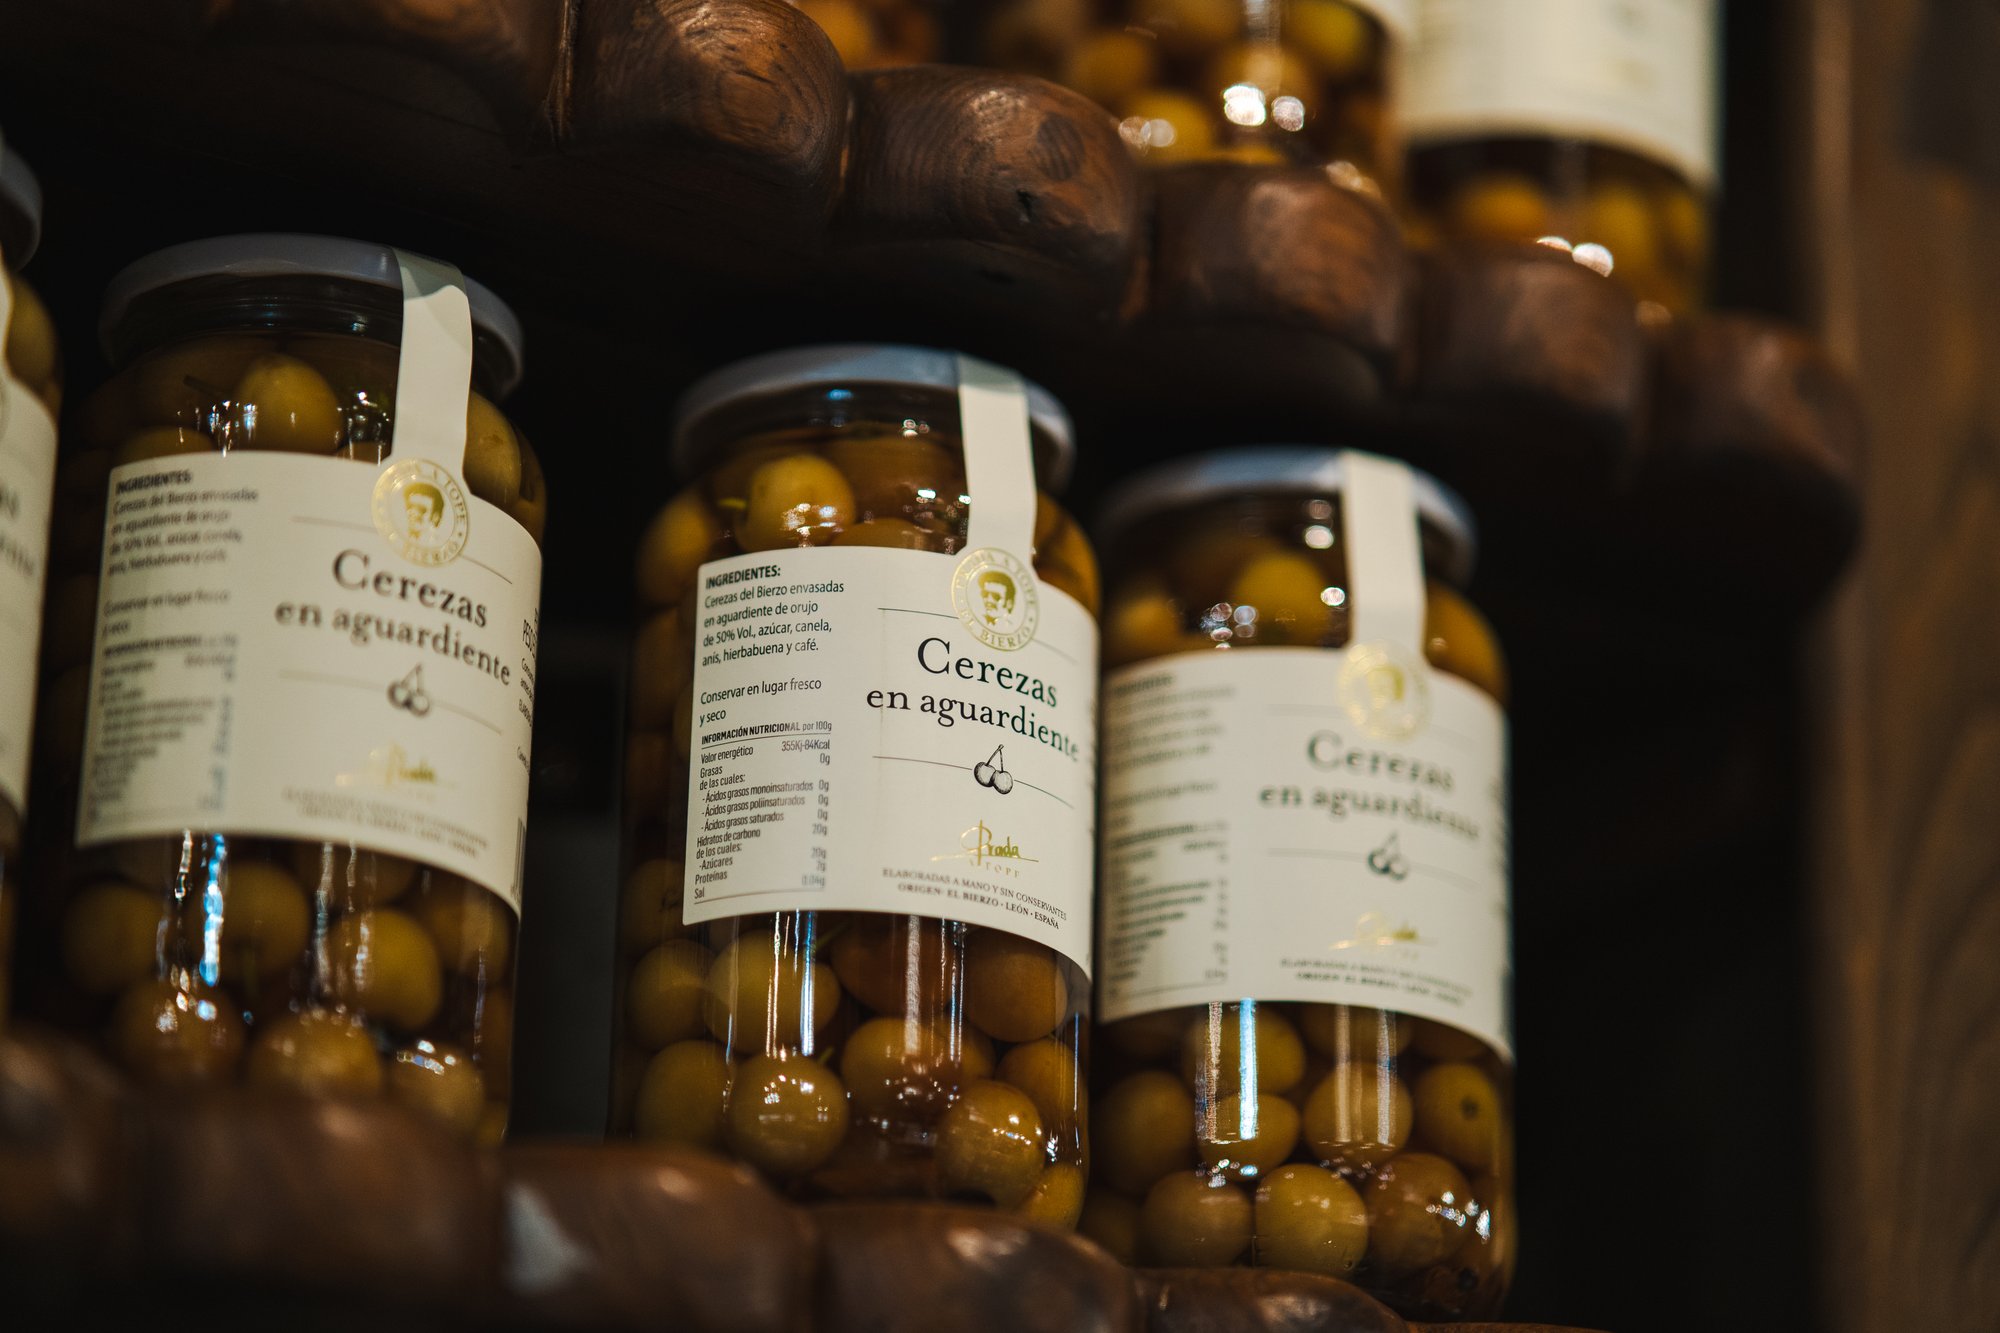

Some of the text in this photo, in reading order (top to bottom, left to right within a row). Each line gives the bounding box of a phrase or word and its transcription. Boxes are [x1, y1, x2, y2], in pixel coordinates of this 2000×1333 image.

[333, 548, 489, 628] Cerezas
[706, 565, 781, 589] INGREDIENTES:
[705, 580, 844, 609] Cerezas del Bierzo envasadas
[704, 601, 818, 628] en aguardiente de orujo
[275, 599, 321, 625] en
[332, 609, 511, 687] aguardiente
[703, 619, 832, 647] de 50% Vol., azúcar, canela,
[702, 639, 819, 667] anís, hierbabuena y café.
[917, 636, 1059, 708] Cerezas
[701, 678, 822, 705] Conservar en lugar fresco
[699, 709, 726, 727] y seco
[866, 690, 911, 711] en
[920, 694, 1081, 763] aguardiente
[701, 720, 832, 745] INFORMACIÓN NUTRICIONAL por 100g
[701, 745, 753, 764] Valor energético
[819, 753, 830, 765] 0g
[1306, 730, 1457, 793] Cerezas
[700, 765, 723, 779] Grasas
[700, 773, 746, 791] de las cuales:
[727, 786, 749, 801] grasos
[750, 781, 813, 797] monoinsaturados
[819, 780, 829, 792] 0g
[1258, 784, 1303, 807] en
[727, 801, 749, 815] grasos
[726, 815, 748, 830] grasos
[749, 812, 784, 826] saturados
[697, 828, 760, 847] Hidratos de carbono
[696, 843, 742, 859] de los cuales:
[695, 871, 727, 885] Proteínas
[695, 888, 705, 899] Sal
[882, 868, 1067, 921] ELABORADAS A MANO Y SIN CONSERVANTES
[947, 890, 960, 898] EL
[963, 893, 999, 907] BIERZO
[1006, 902, 1029, 916] LEÓN
[1034, 911, 1059, 930] ESPAÑA
